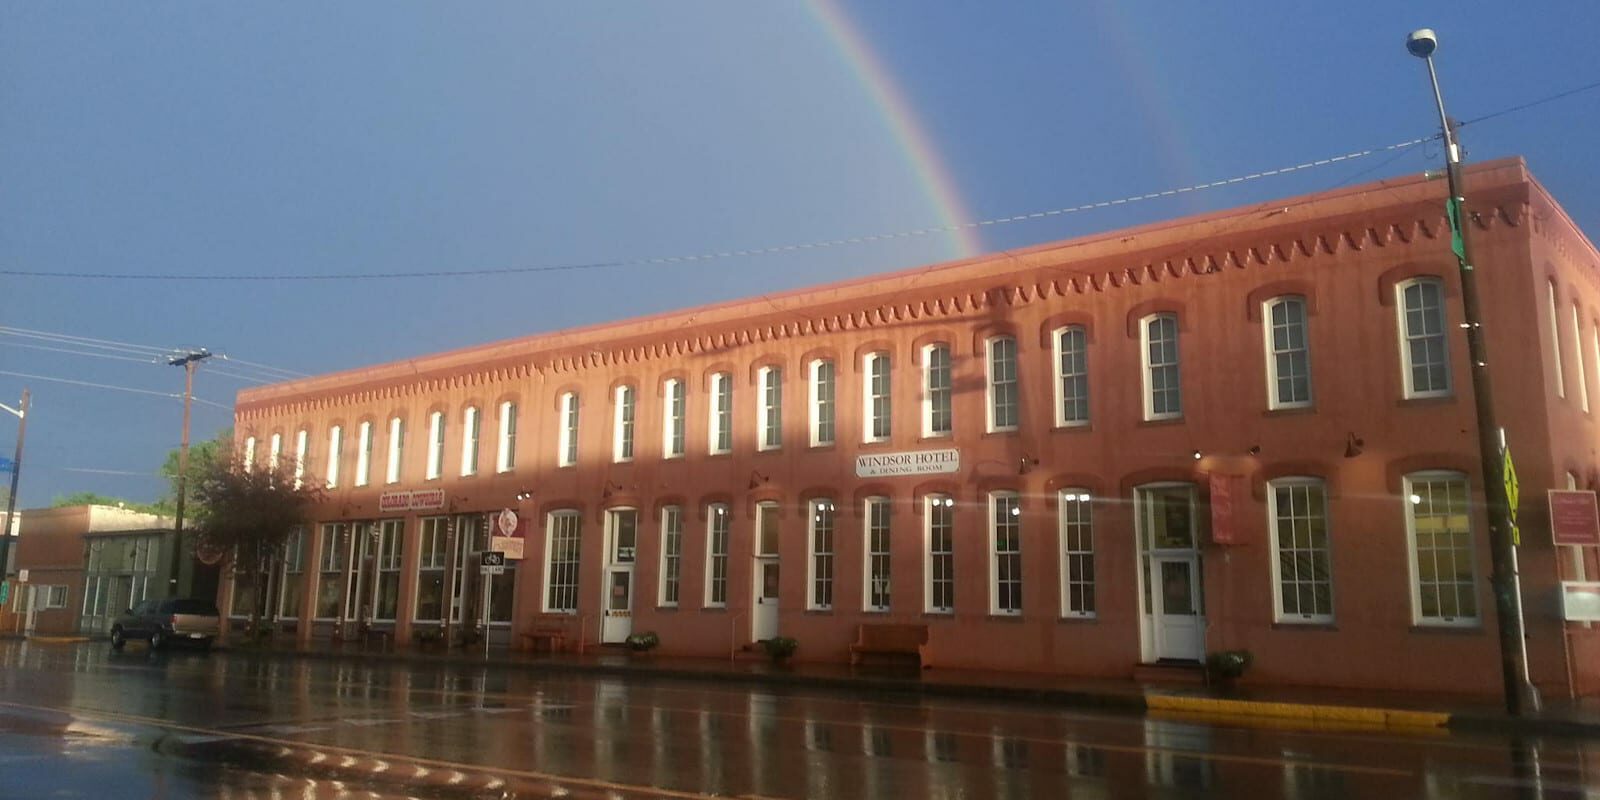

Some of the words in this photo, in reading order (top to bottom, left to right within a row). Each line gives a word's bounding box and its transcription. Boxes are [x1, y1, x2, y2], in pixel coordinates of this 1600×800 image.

[858, 455, 911, 468] WINDSOR
[915, 451, 957, 464] HOTEL
[880, 466, 912, 474] DINING
